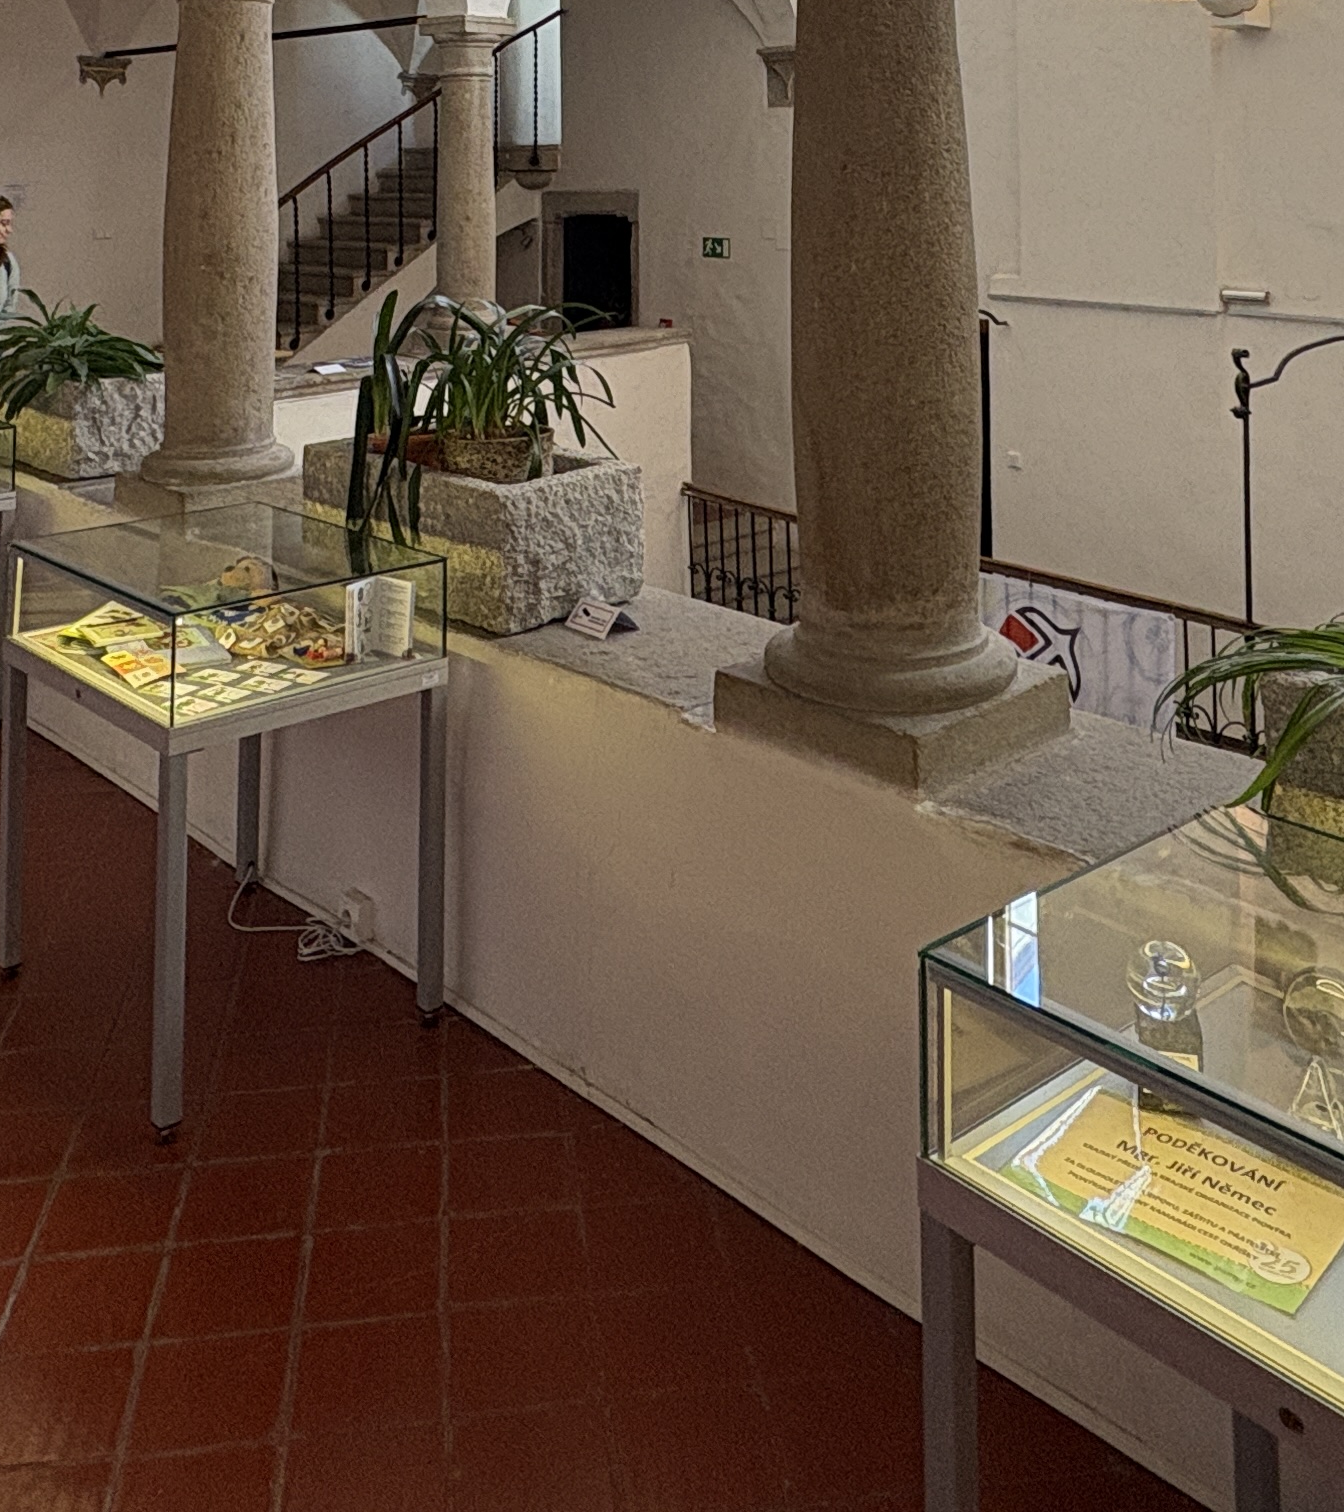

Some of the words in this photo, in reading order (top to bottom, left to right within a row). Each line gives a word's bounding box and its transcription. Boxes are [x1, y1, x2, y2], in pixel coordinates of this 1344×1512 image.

[1142, 1126, 1287, 1192] PODĚKOVÁNÍ
[1166, 1160, 1202, 1180] Jiří
[1201, 1175, 1277, 1217] Němec
